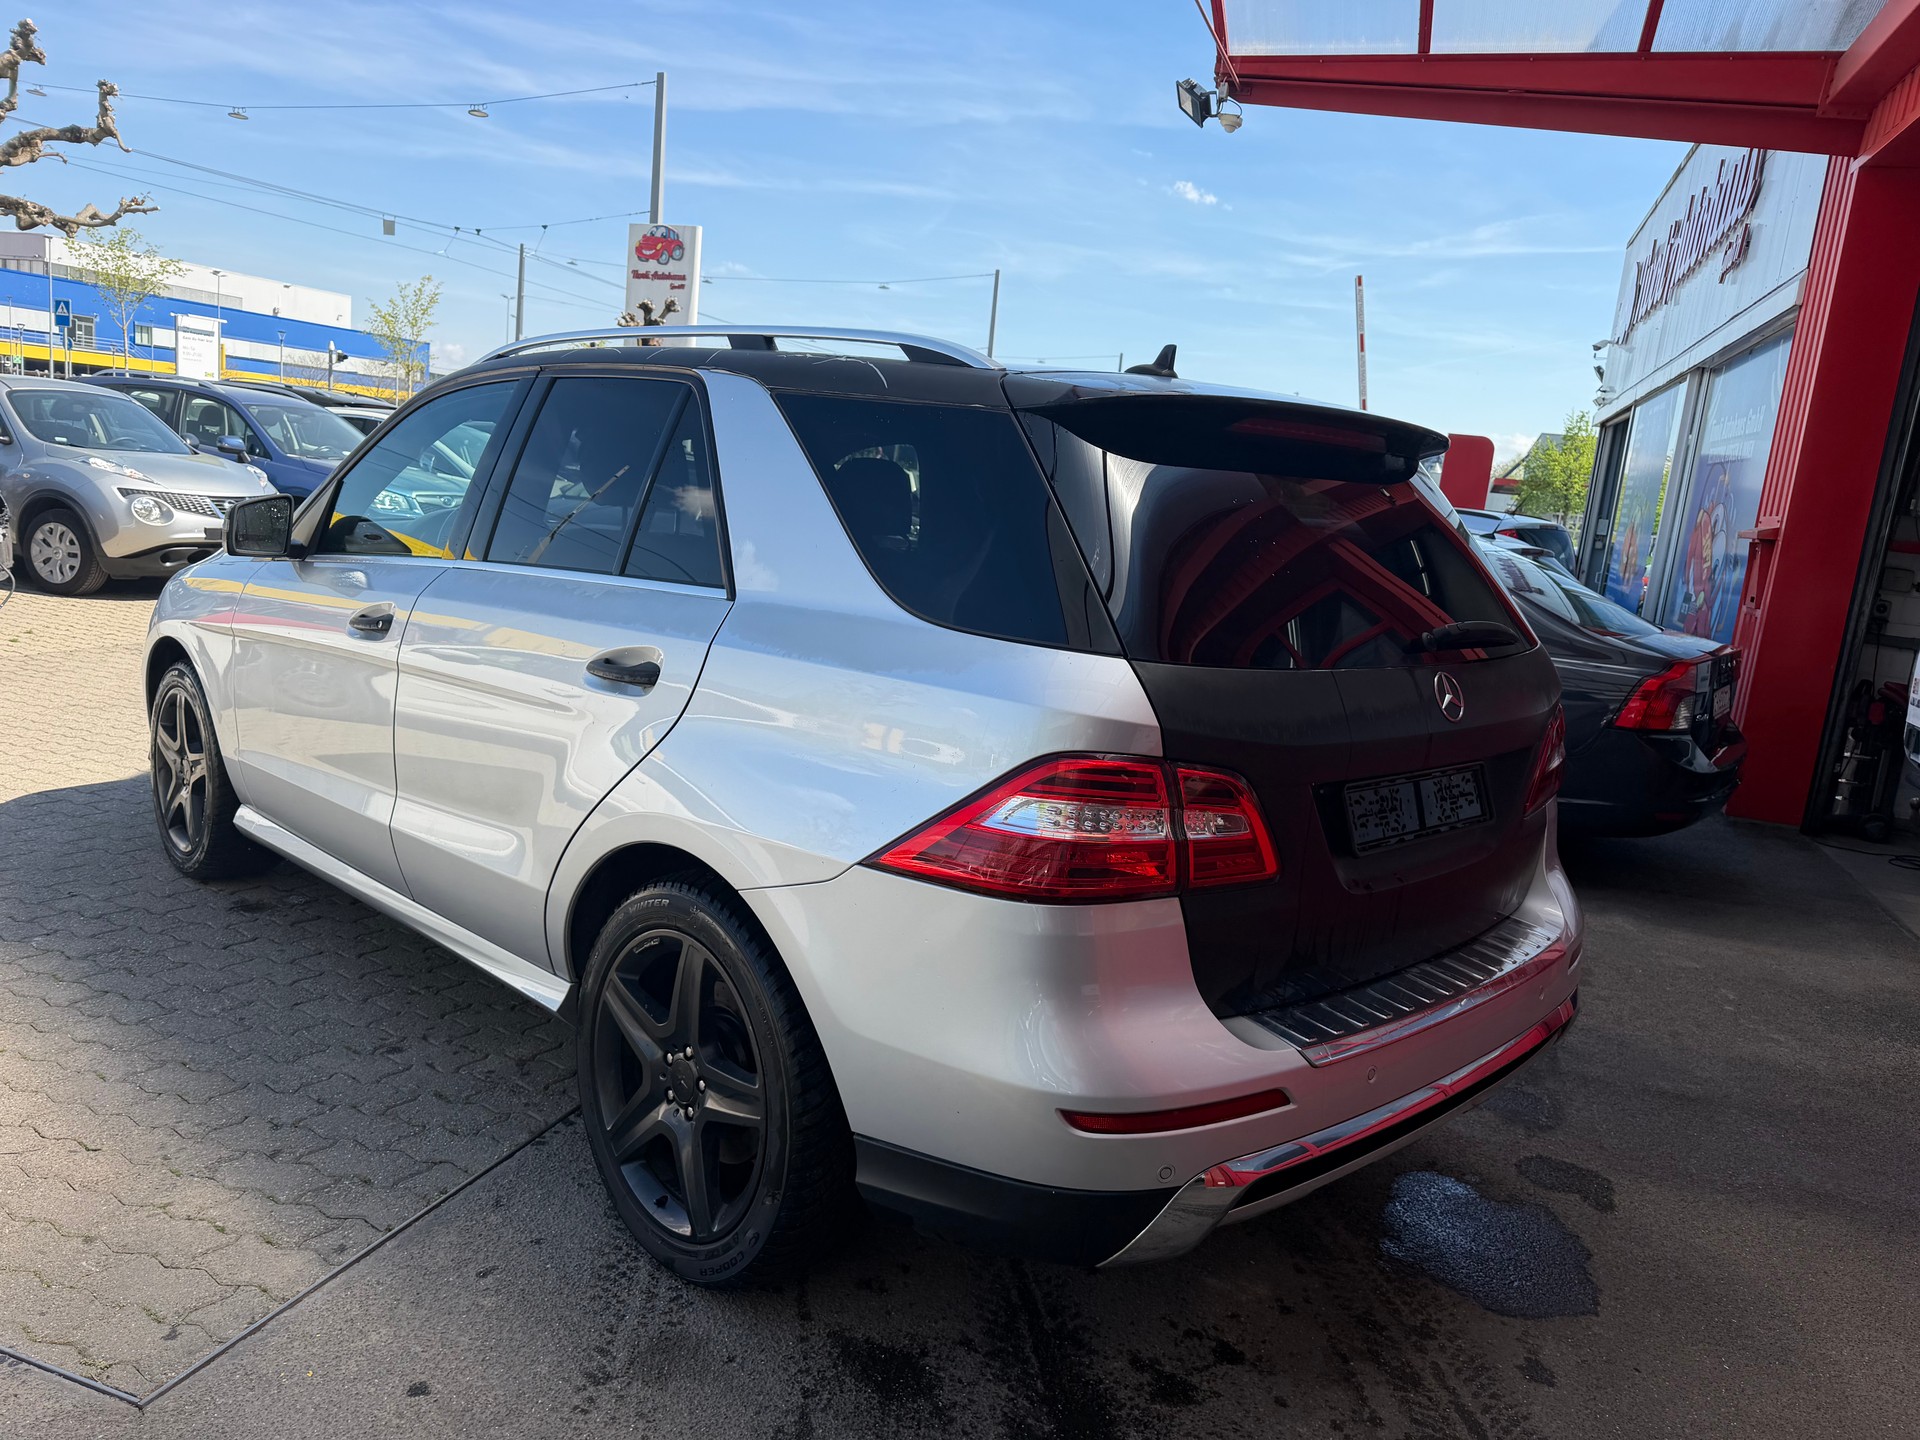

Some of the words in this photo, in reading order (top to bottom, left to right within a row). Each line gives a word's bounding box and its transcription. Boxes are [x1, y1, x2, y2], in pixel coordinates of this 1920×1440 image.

[650, 270, 687, 281] Autohaus
[627, 898, 671, 915] WINTER
[699, 1250, 745, 1276] COOPER
